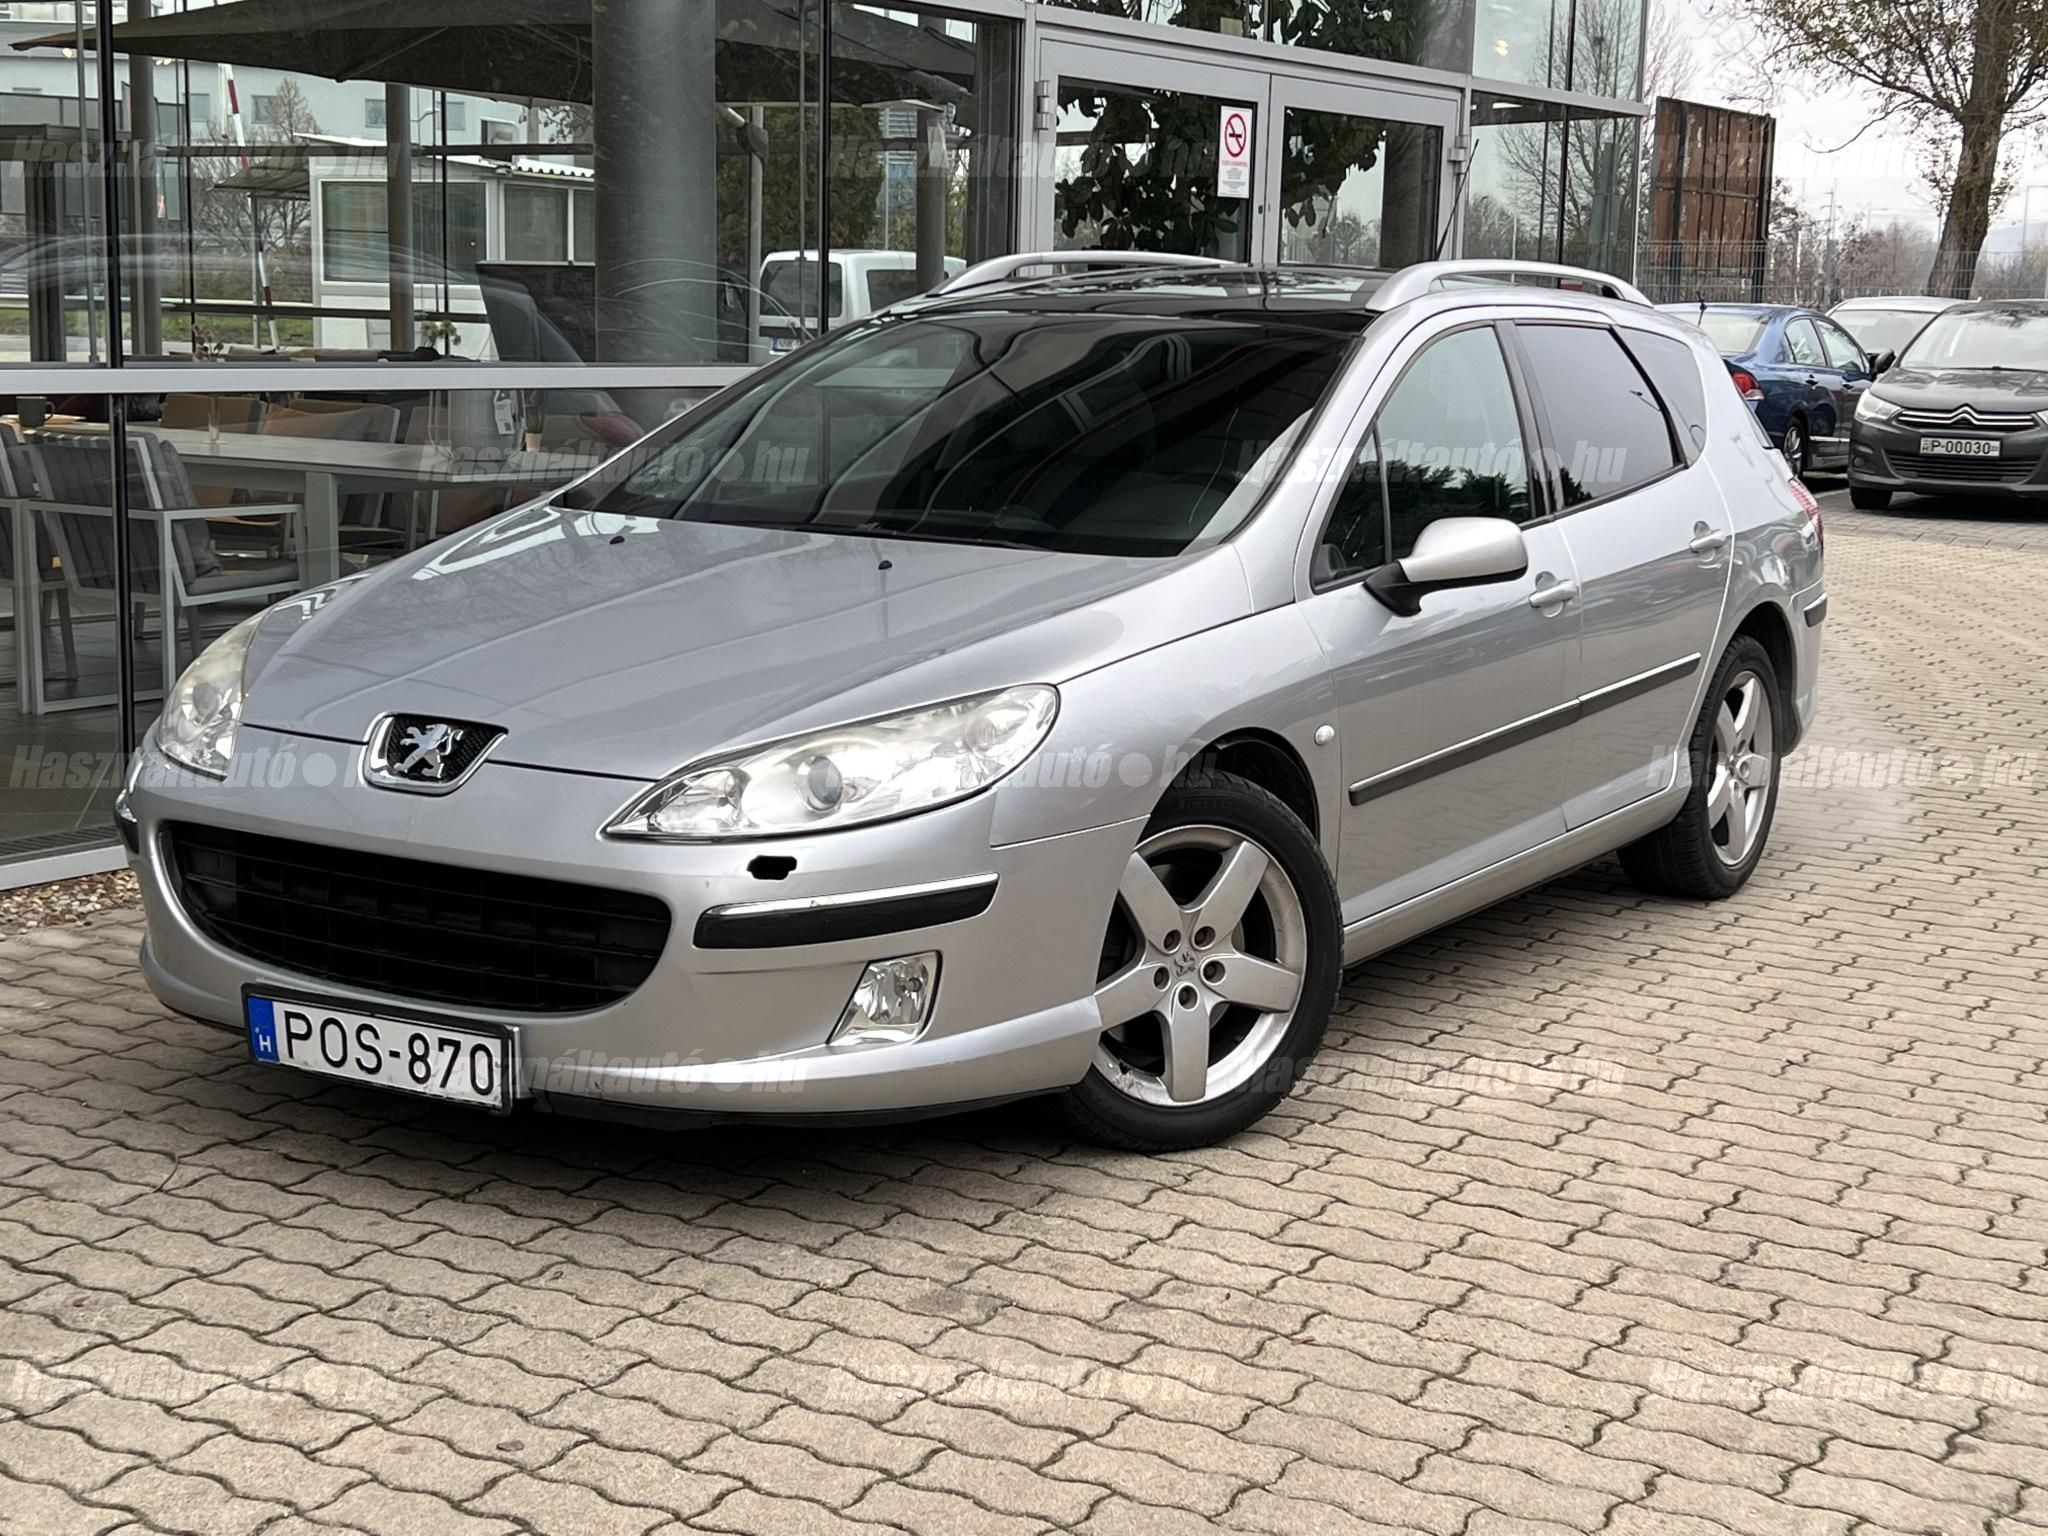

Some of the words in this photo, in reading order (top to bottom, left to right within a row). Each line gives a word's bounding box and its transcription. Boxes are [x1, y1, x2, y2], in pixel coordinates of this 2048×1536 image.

[1931, 440, 1991, 454] P-00030
[259, 1034, 272, 1053] H
[284, 1010, 494, 1096] POS-870
